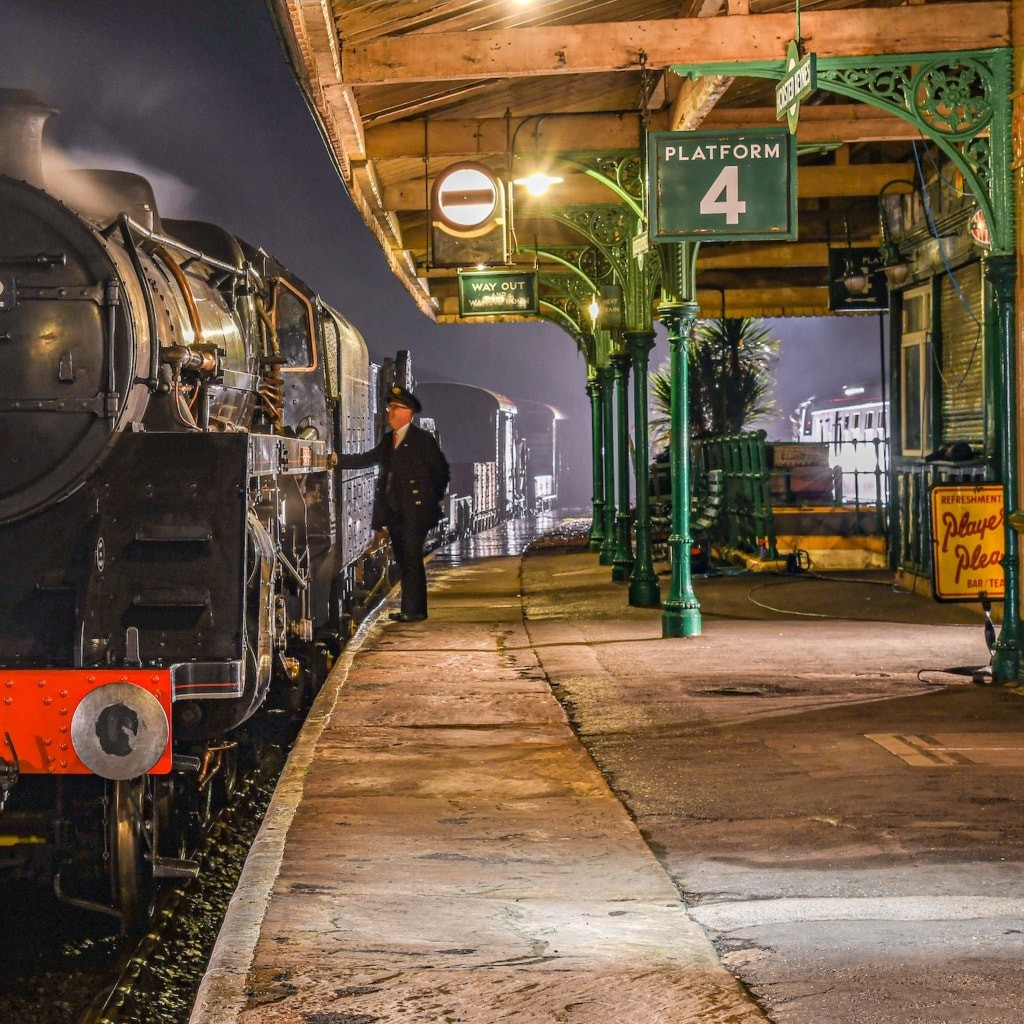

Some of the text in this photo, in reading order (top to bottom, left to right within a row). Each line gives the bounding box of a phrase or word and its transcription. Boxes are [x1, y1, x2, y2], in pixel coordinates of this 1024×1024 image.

[665, 143, 780, 161] PLATFORM
[699, 165, 746, 225] 4
[471, 281, 526, 292] WAY OUT
[941, 494, 1002, 505] REFRESHMENT
